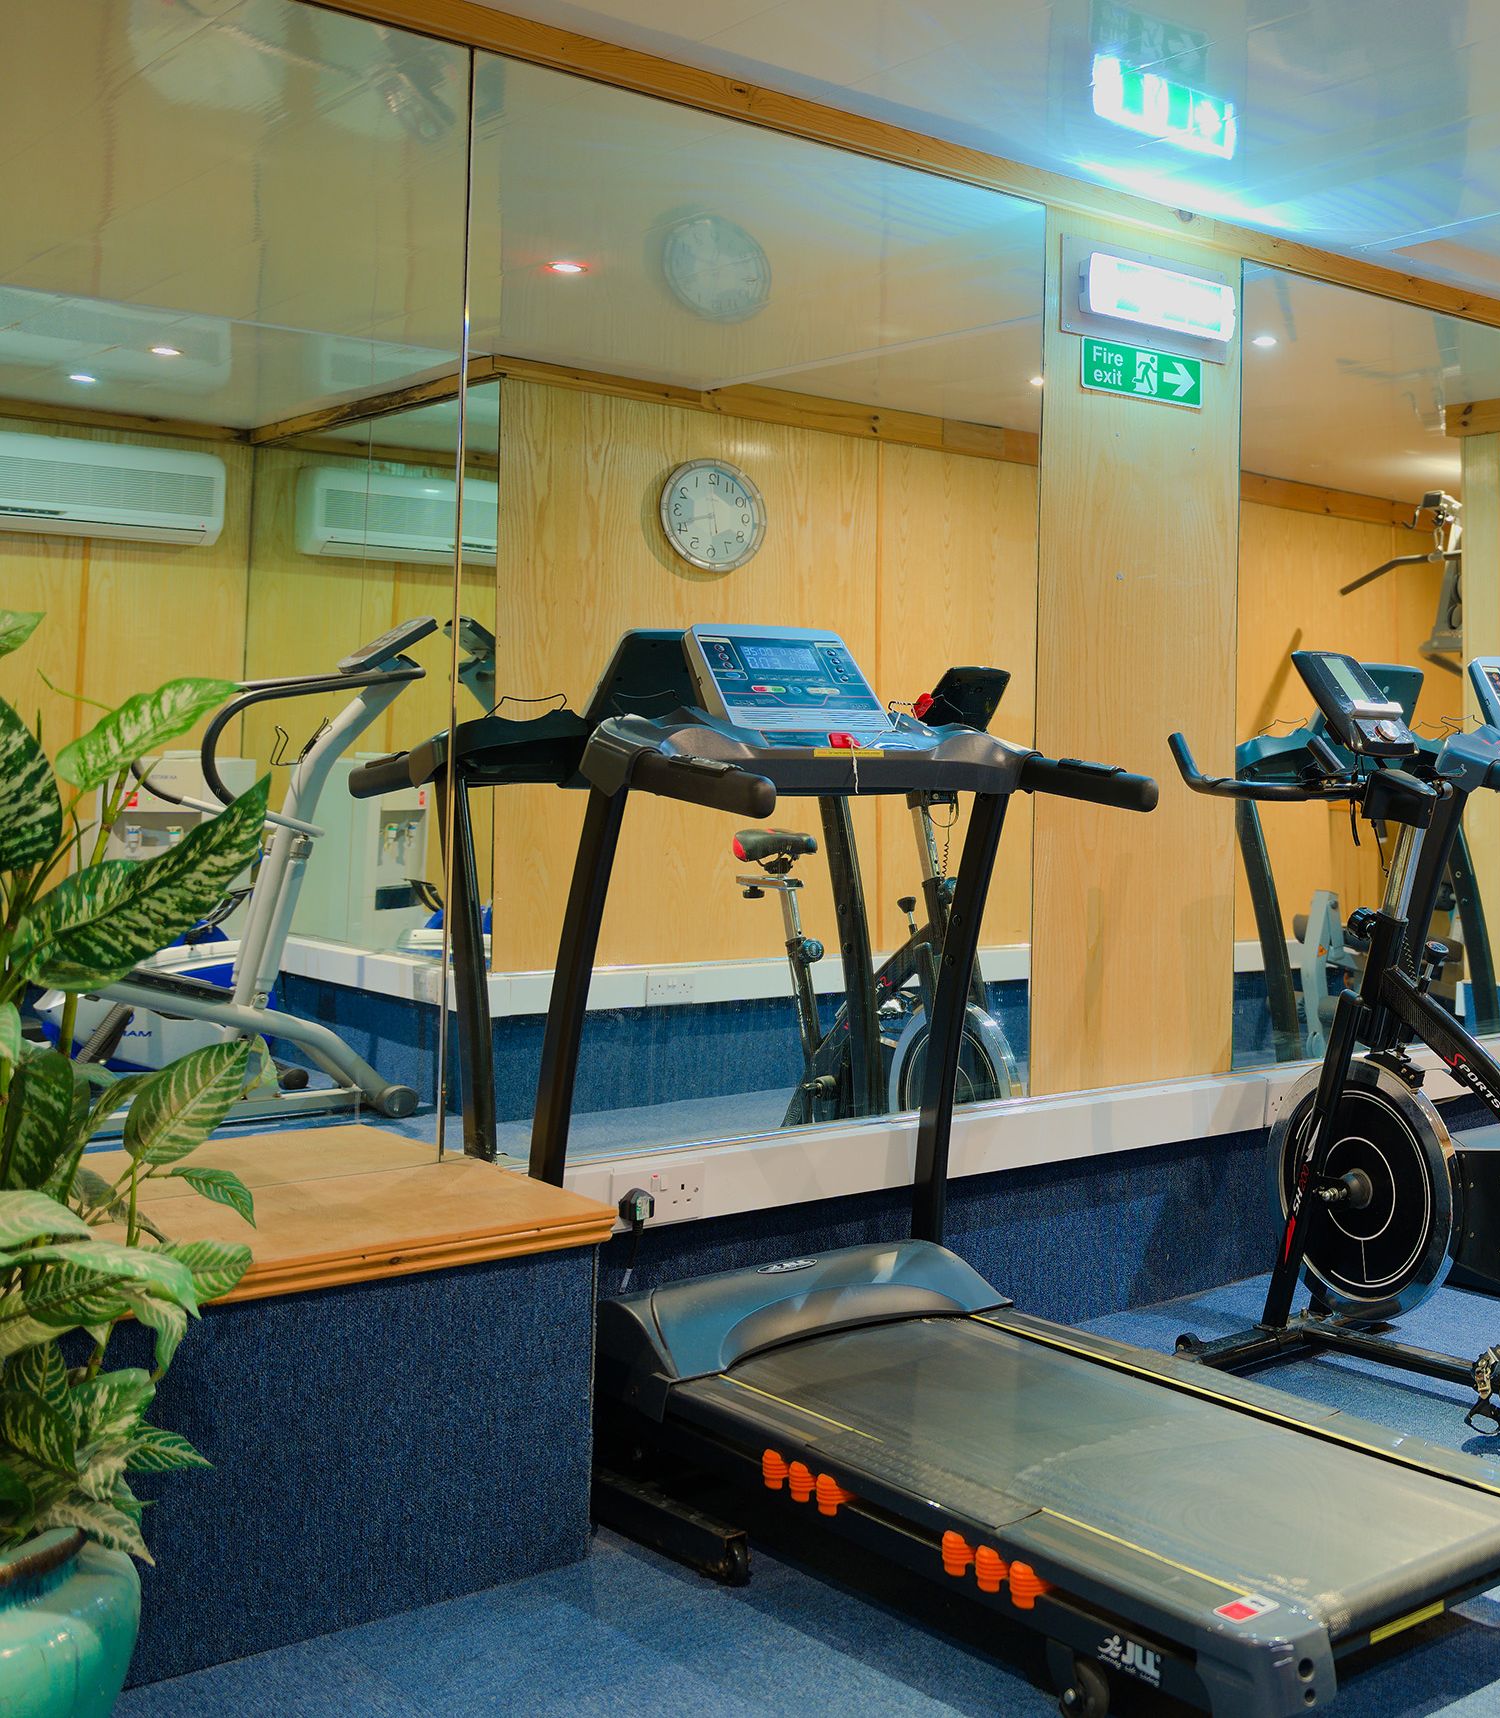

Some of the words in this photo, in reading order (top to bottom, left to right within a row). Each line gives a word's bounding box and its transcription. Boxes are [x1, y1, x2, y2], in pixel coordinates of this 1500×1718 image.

[1093, 345, 1124, 367] Fire
[1093, 368, 1122, 386] exit
[1121, 1640, 1160, 1680] JLL
